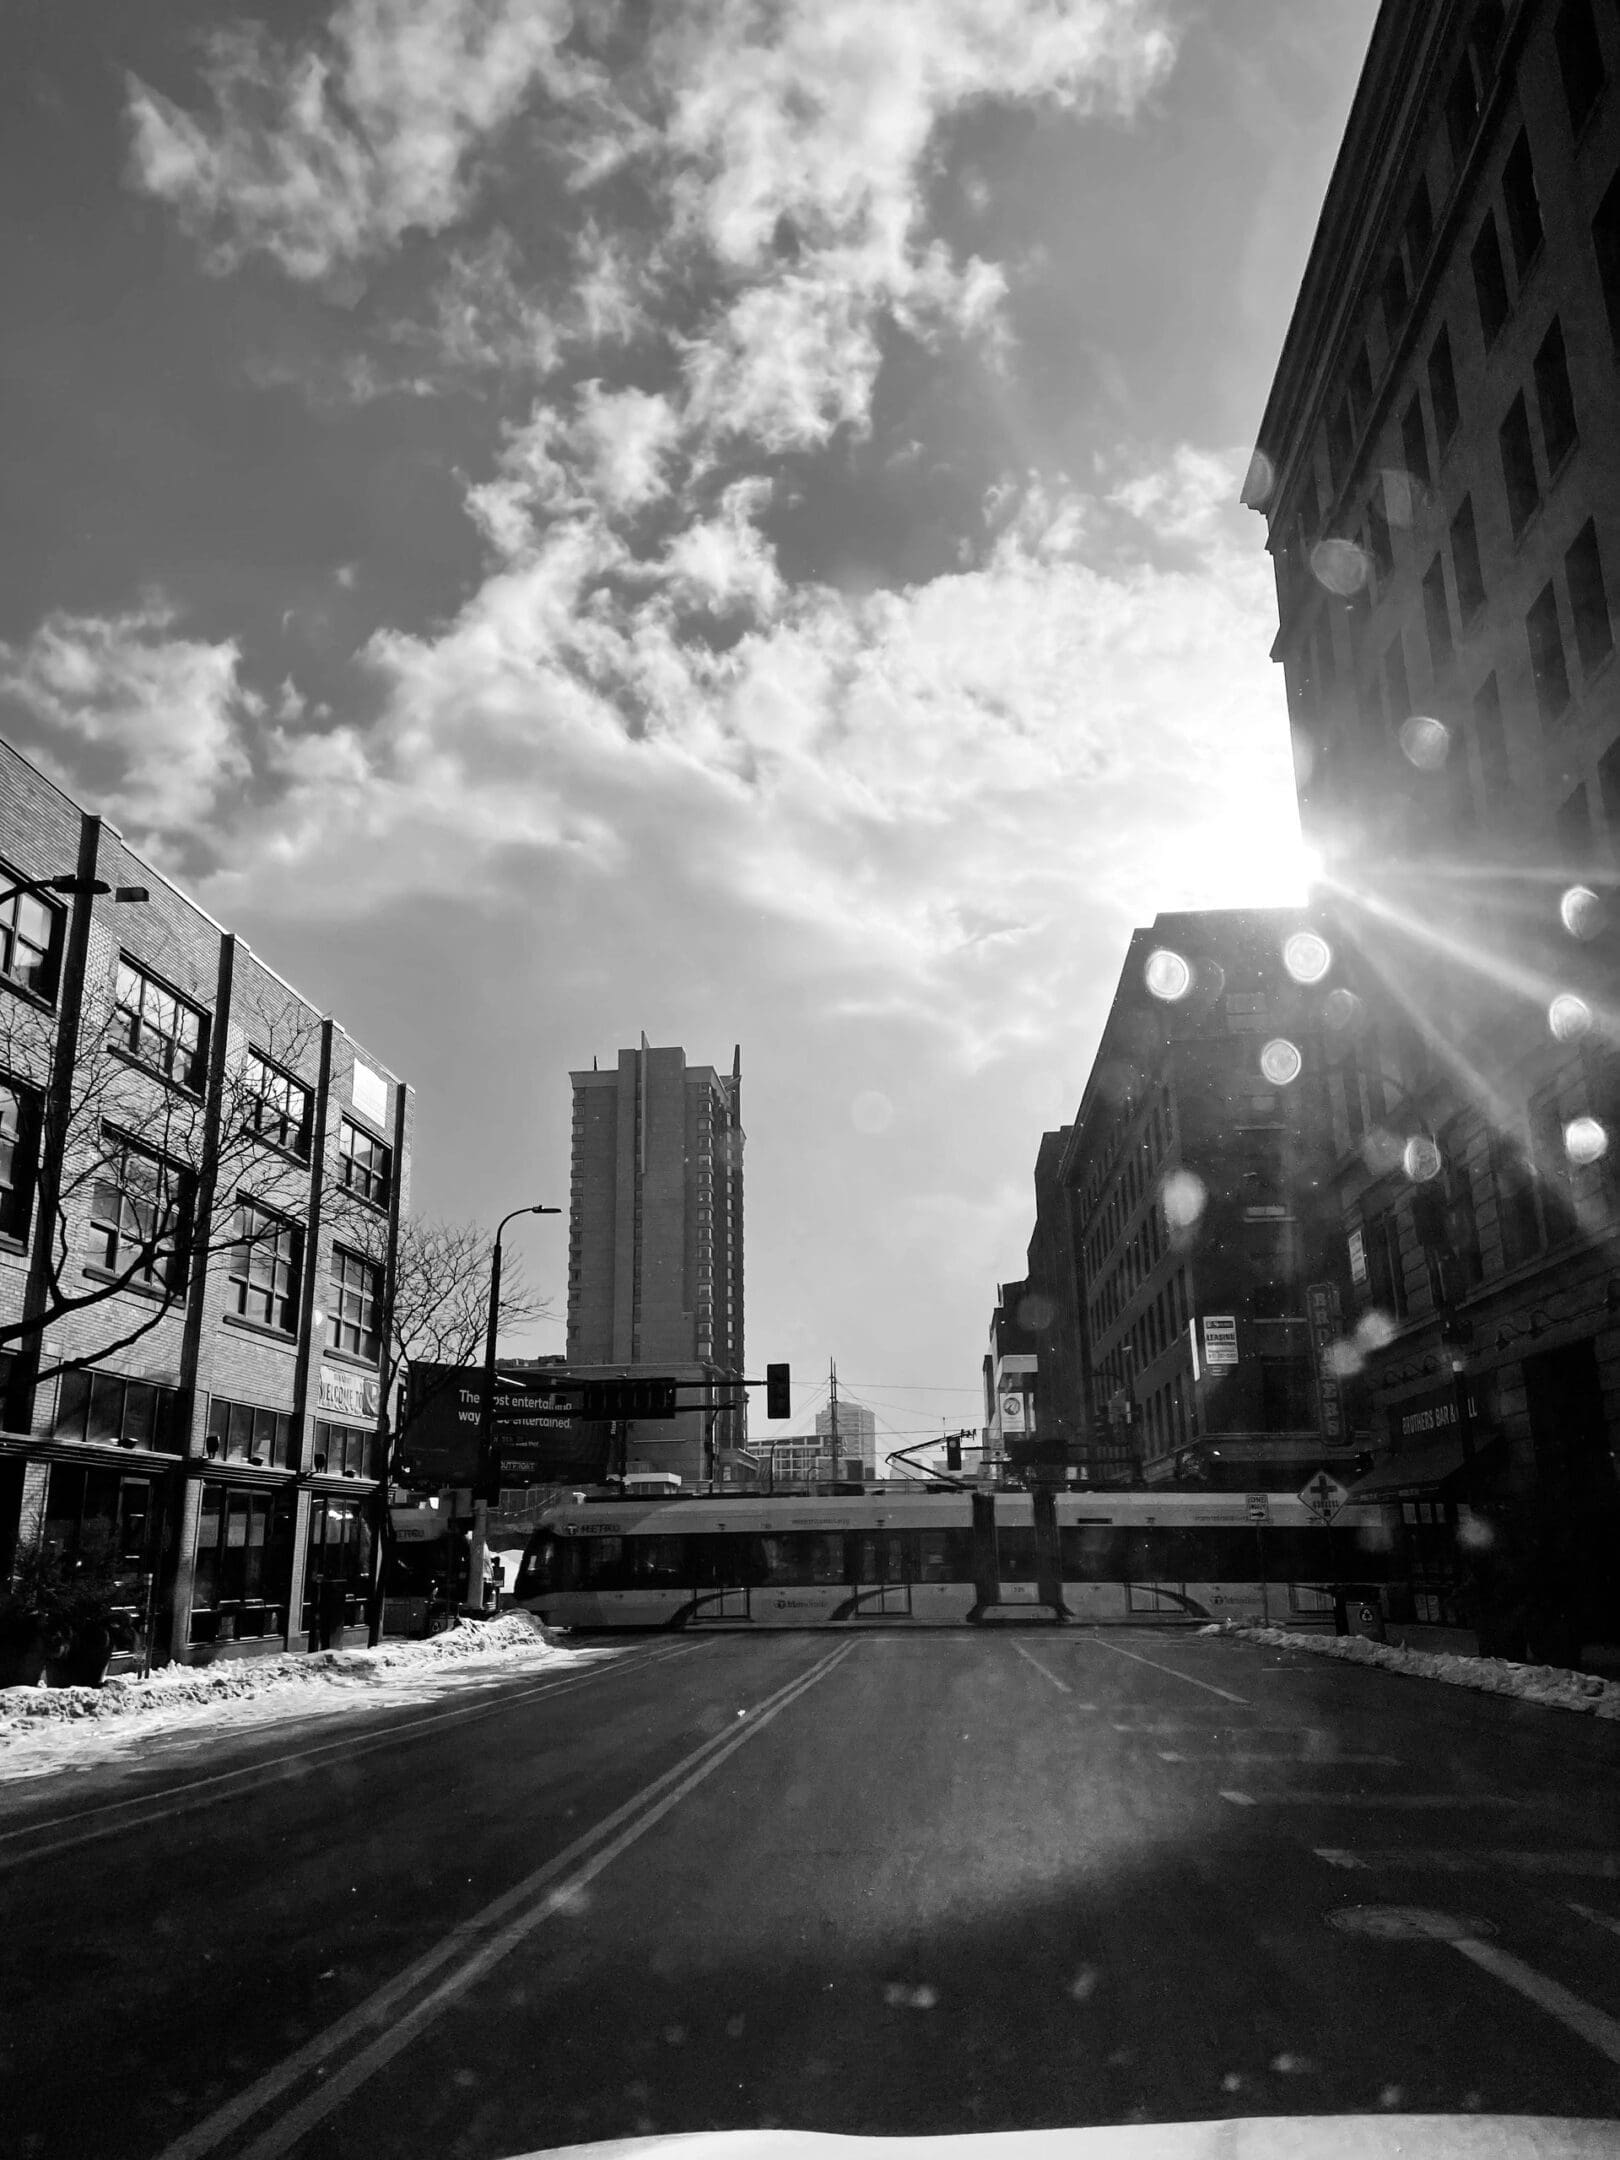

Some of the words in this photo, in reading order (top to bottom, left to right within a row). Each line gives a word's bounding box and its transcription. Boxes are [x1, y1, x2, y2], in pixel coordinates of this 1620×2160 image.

[459, 1389, 480, 1404] The
[458, 1411, 481, 1426] way
[1402, 1409, 1434, 1435] BROTHERS
[1435, 1405, 1449, 1427] BAR
